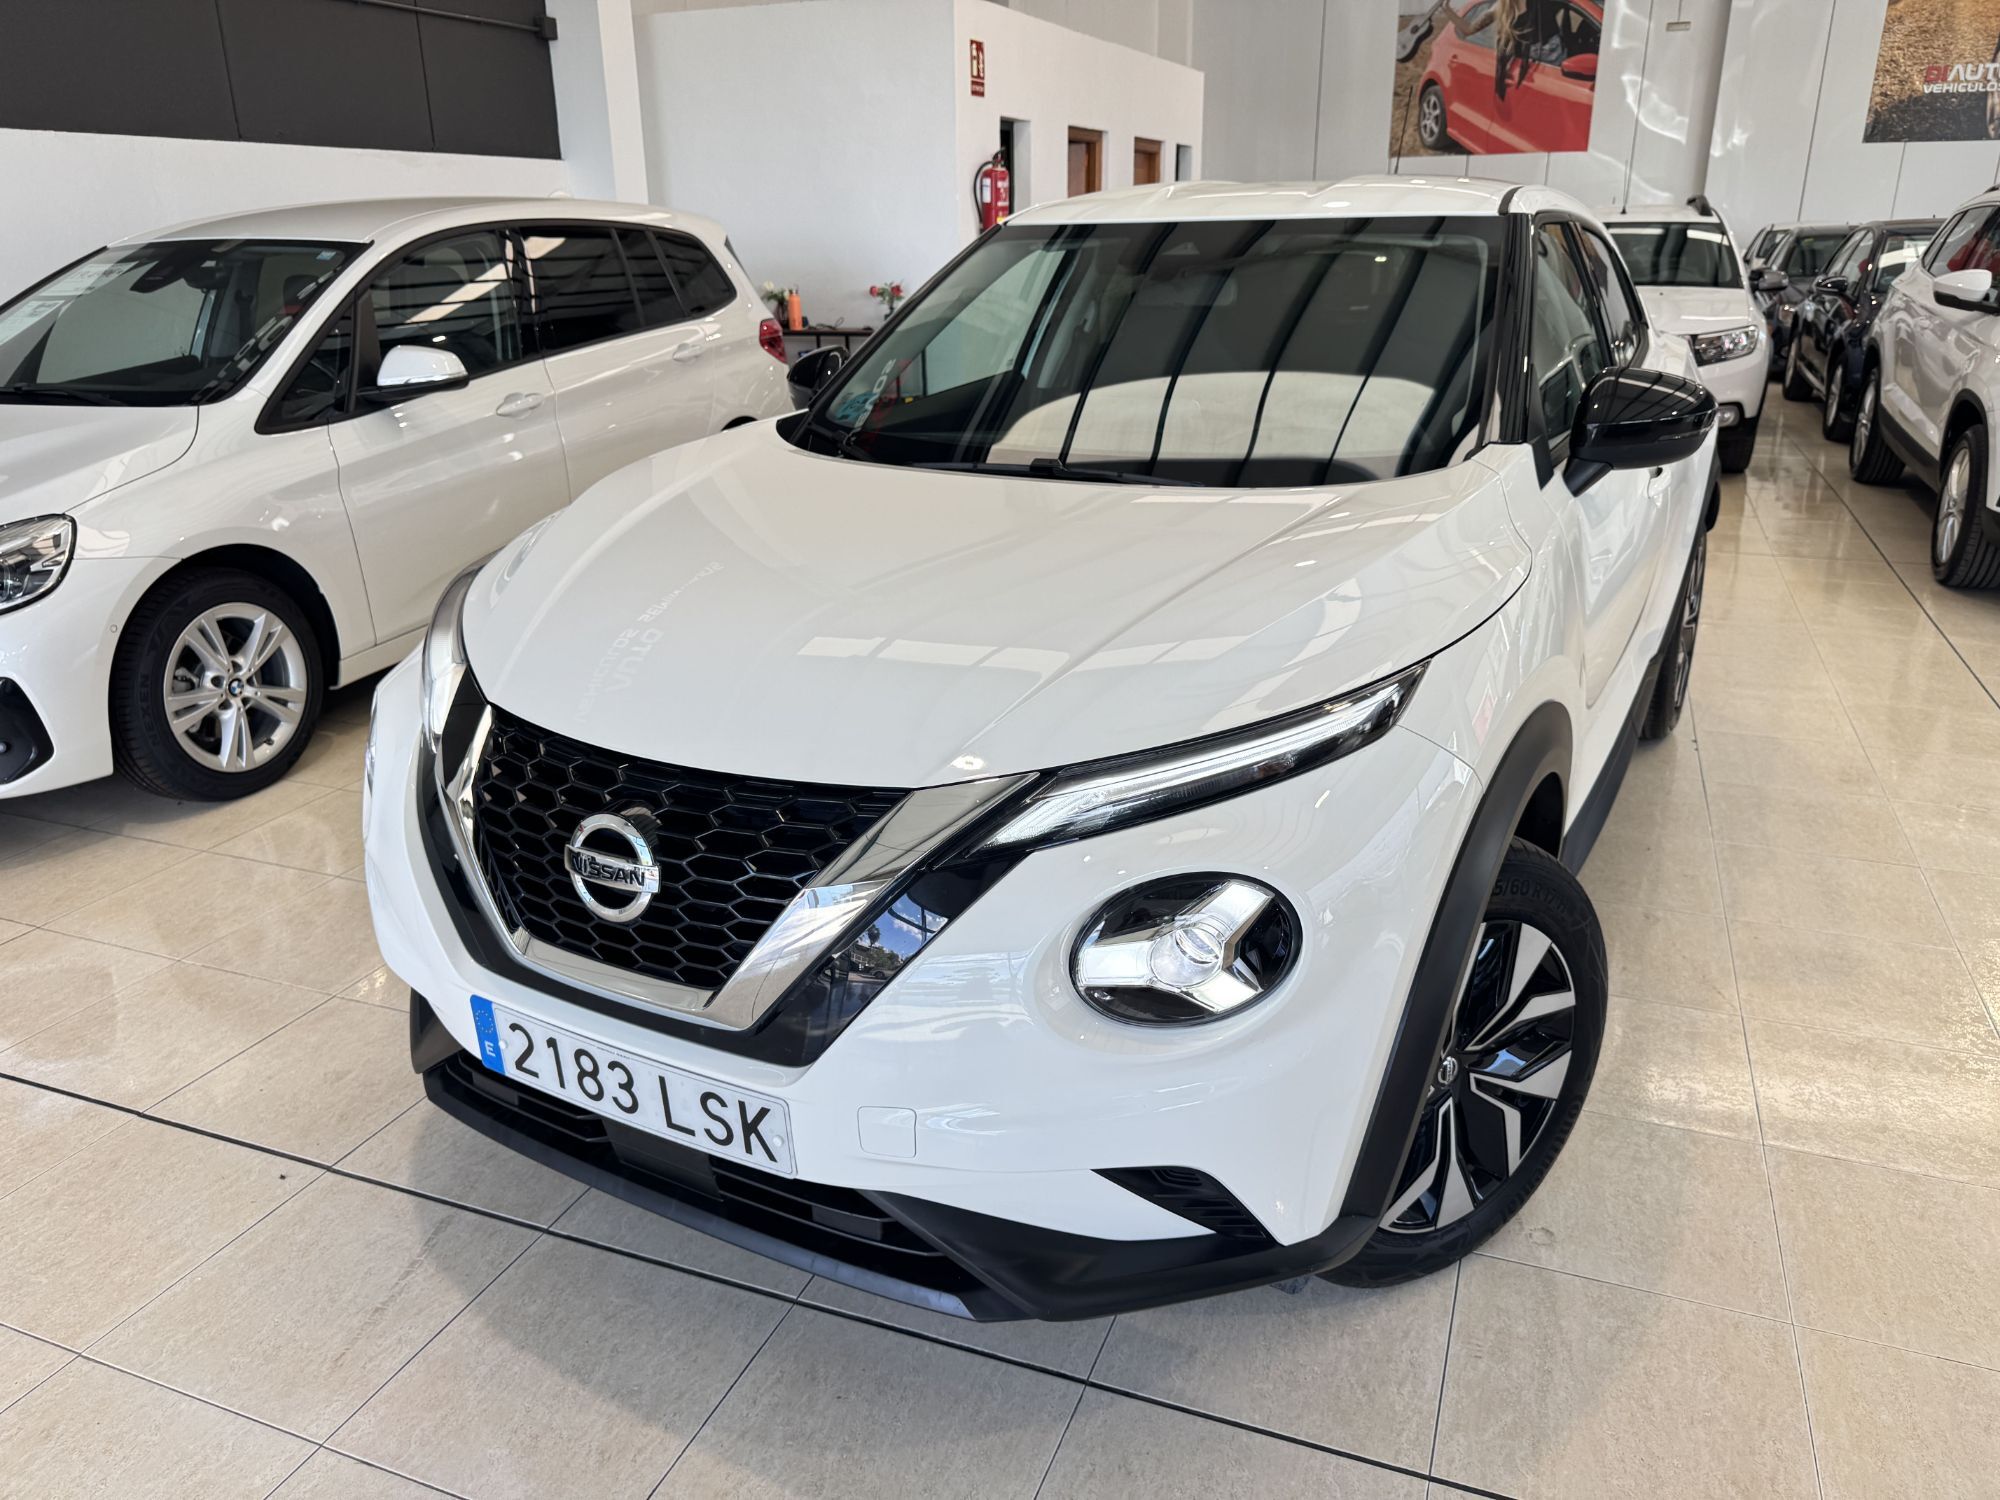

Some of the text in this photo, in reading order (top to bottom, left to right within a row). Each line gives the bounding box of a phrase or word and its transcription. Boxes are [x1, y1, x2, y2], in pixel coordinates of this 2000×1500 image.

[1923, 63, 2000, 82] DIAUT
[1923, 81, 2000, 94] VEHICULO
[139, 674, 161, 747] NEXEN
[570, 850, 645, 887] NISSAN
[484, 1041, 495, 1058] E
[509, 1022, 778, 1163] 2183 LSK
